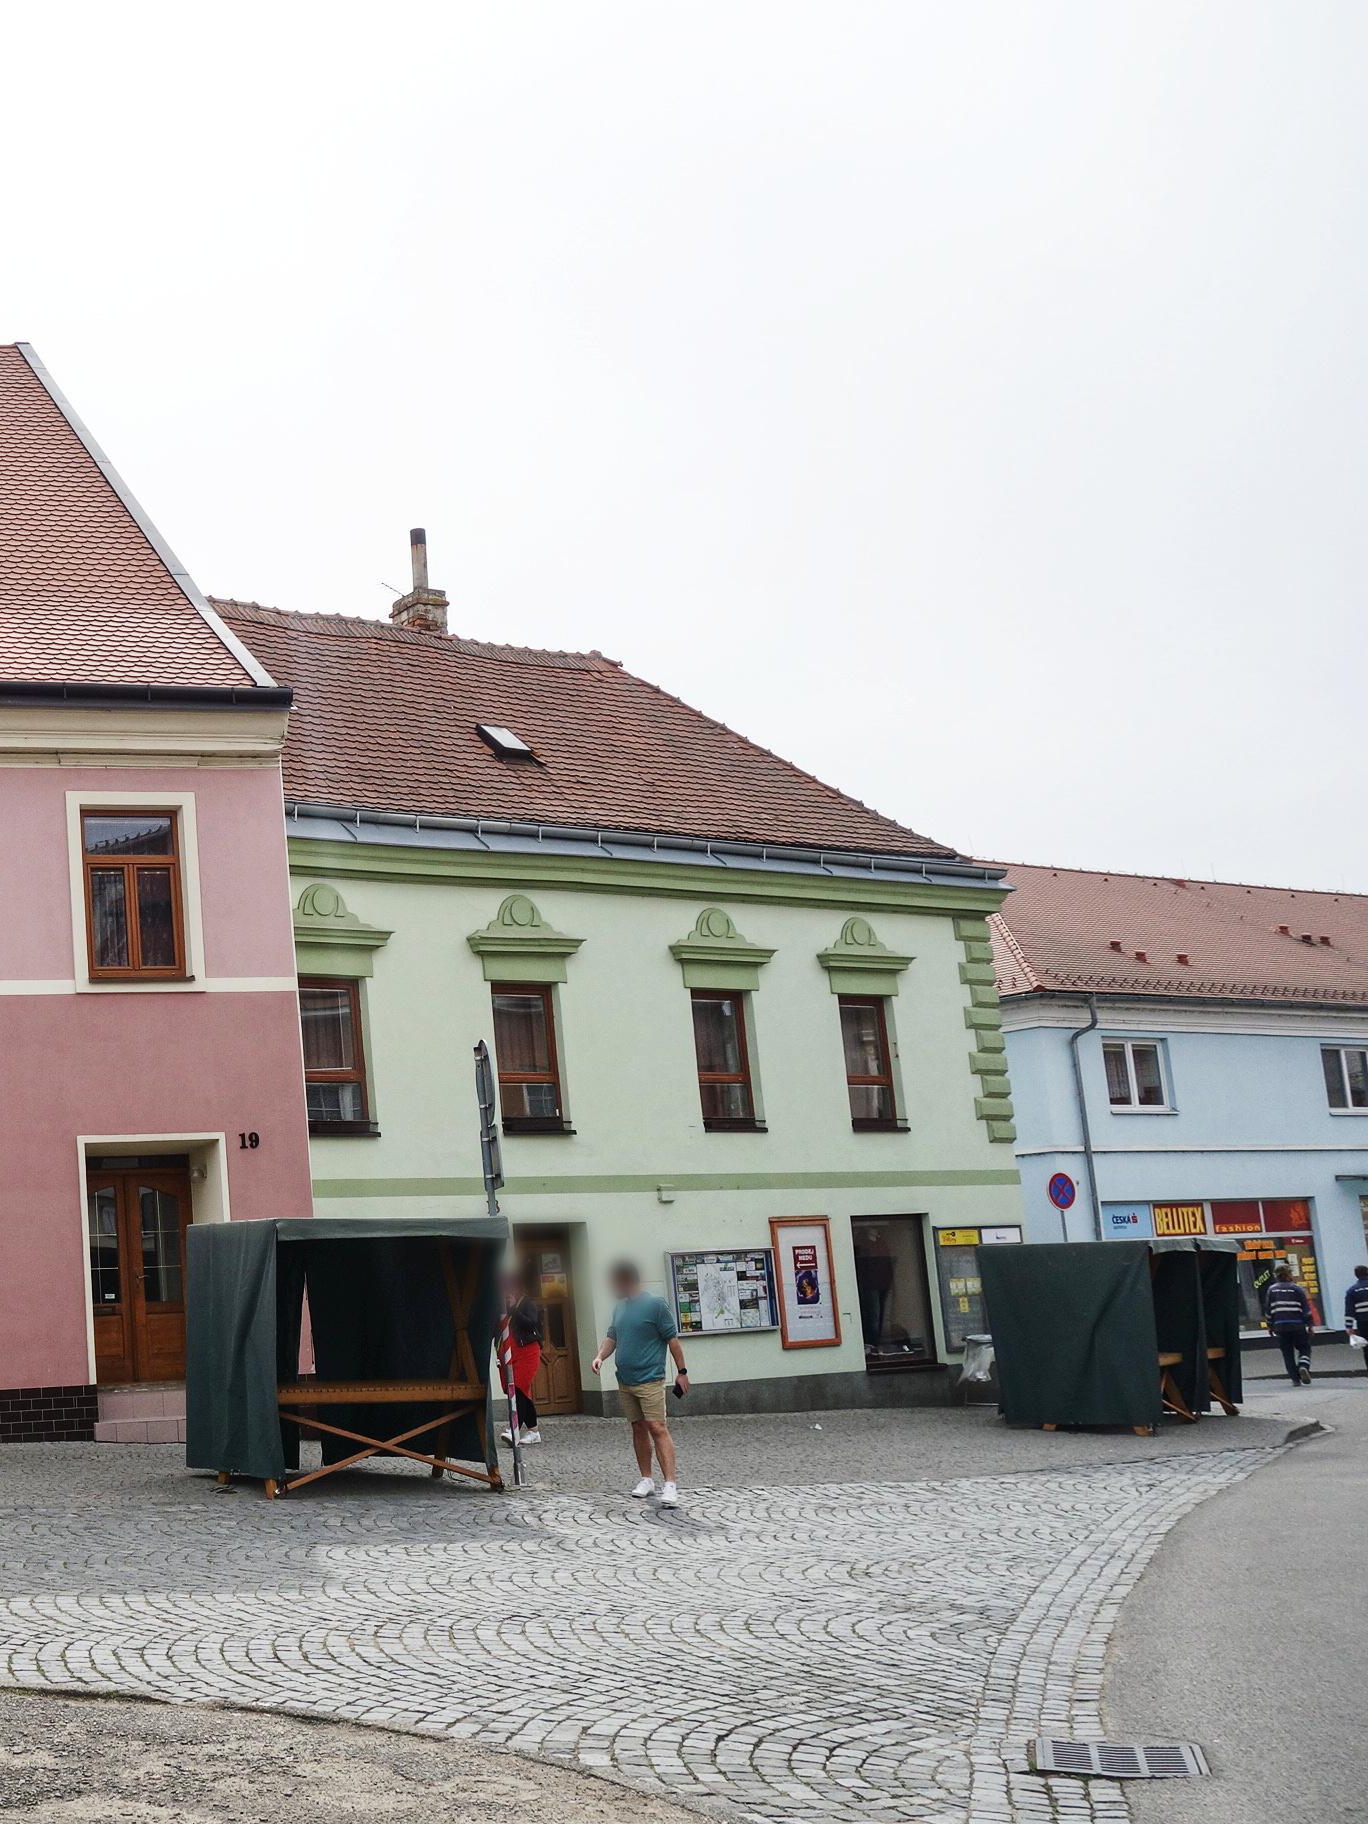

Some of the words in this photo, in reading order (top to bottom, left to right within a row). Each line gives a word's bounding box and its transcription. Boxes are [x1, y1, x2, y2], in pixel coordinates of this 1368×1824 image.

[238, 1131, 260, 1150] 19
[1111, 1213, 1131, 1225] ČESKÁ
[1154, 1207, 1207, 1236] BELLITEX
[1215, 1222, 1261, 1234] fashion
[1253, 1269, 1272, 1289] OUTLET
